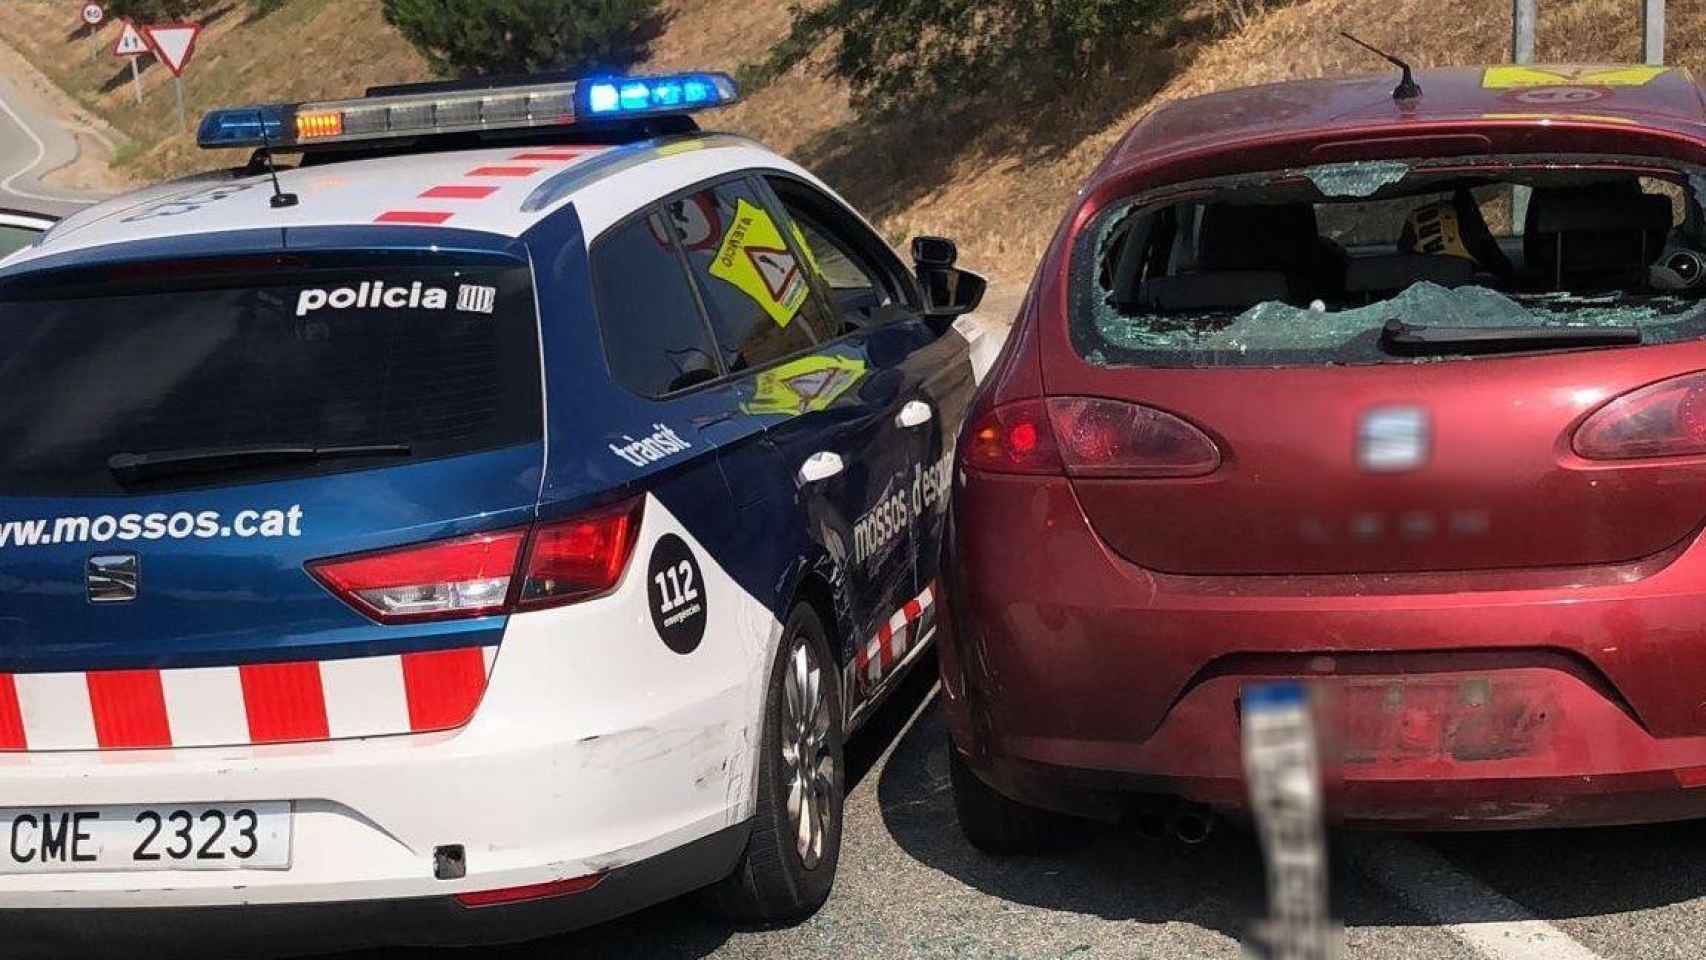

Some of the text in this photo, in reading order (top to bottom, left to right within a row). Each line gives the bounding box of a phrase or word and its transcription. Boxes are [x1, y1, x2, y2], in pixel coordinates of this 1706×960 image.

[296, 281, 447, 316] policia
[854, 488, 907, 564] mossos
[655, 559, 698, 613] 112
[10, 808, 258, 863] CME 2323
